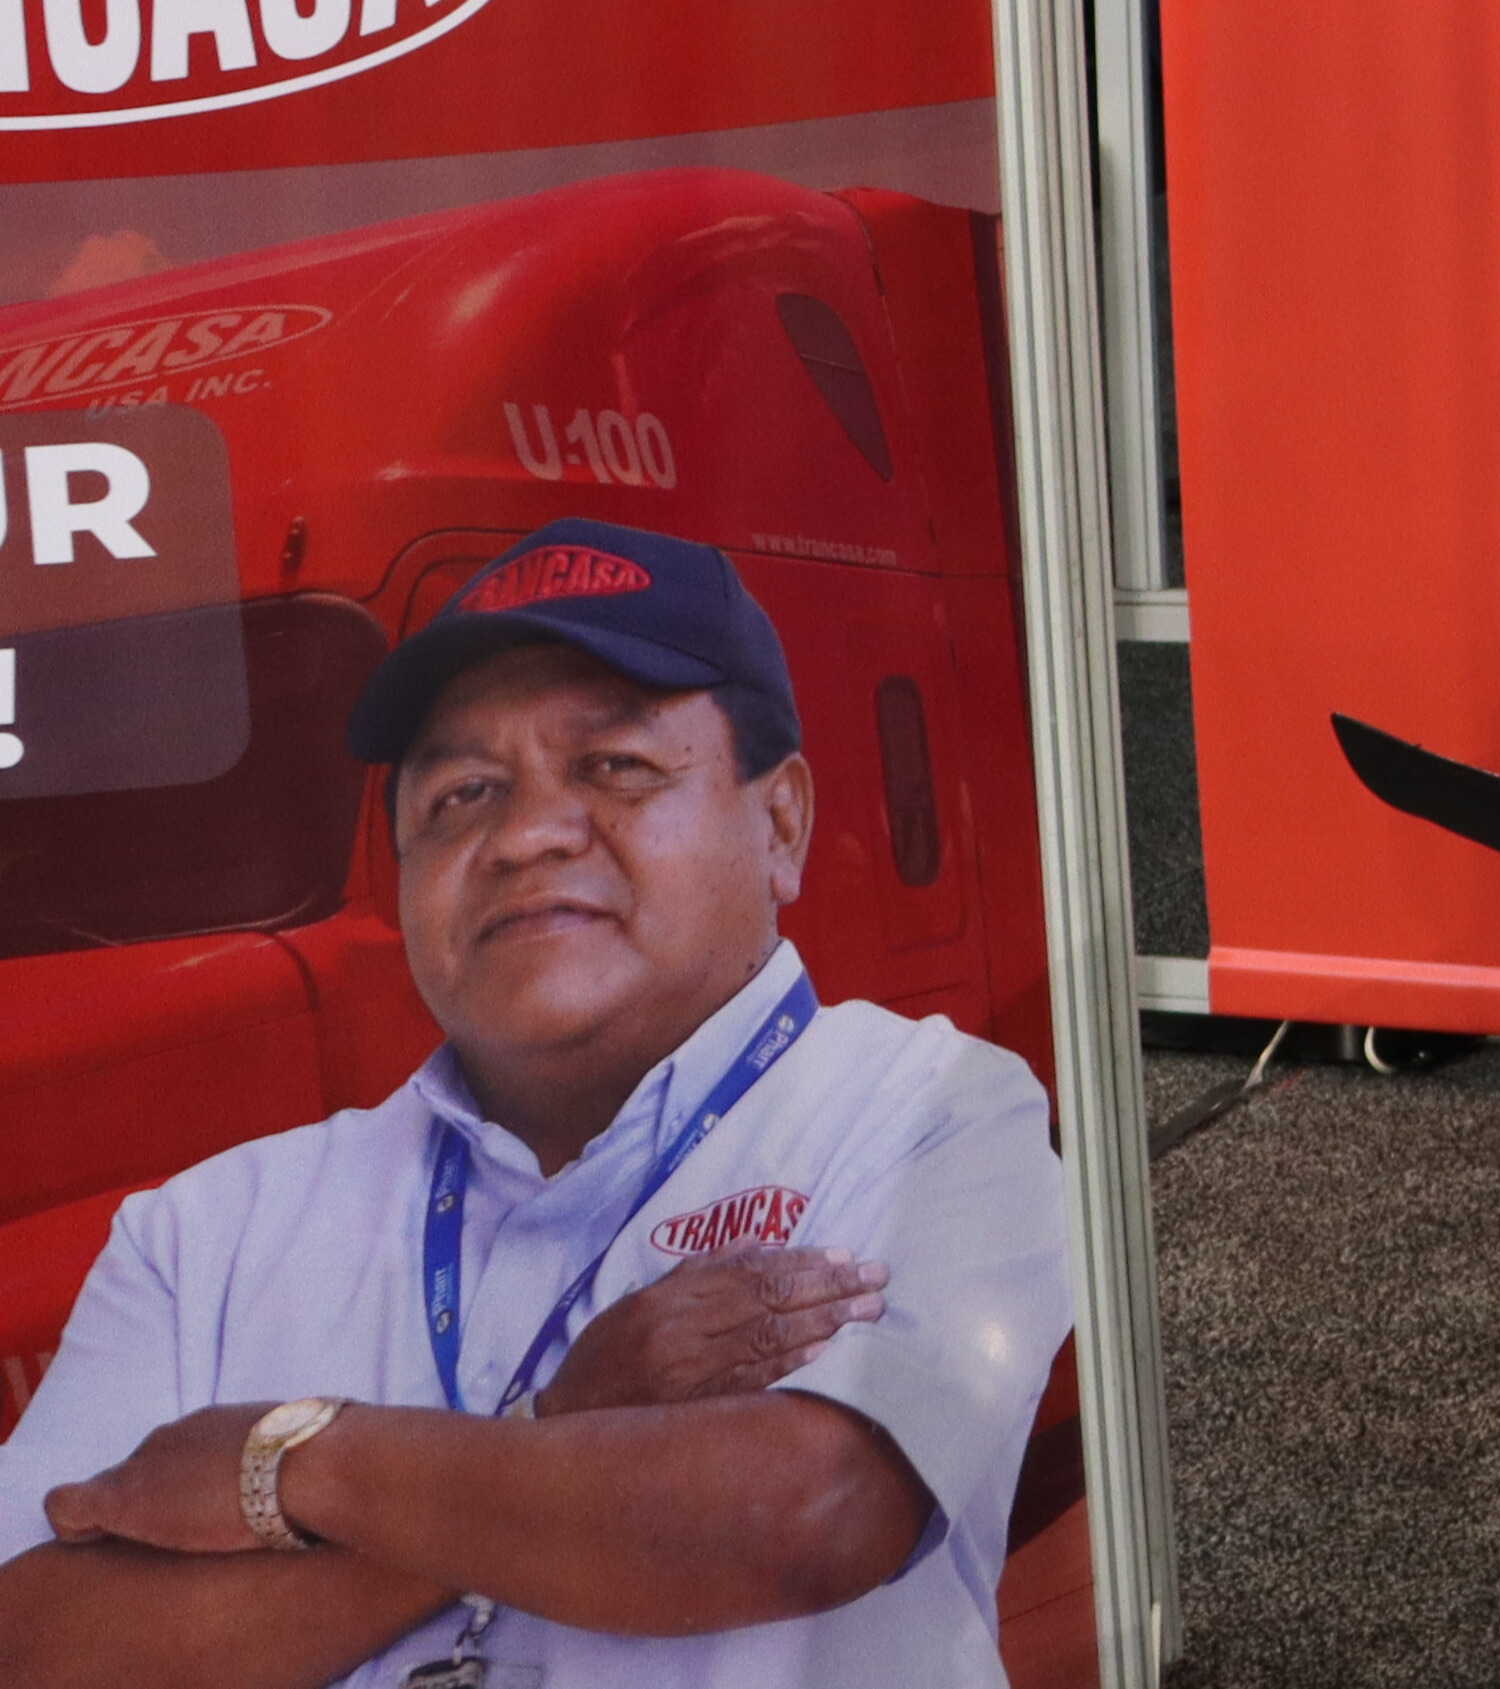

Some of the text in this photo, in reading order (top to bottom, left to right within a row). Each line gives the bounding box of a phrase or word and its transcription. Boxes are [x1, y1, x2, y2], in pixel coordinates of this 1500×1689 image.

[186, 368, 273, 403] INC.
[502, 401, 678, 490] U-100
[666, 1189, 804, 1253] TRANCAS
